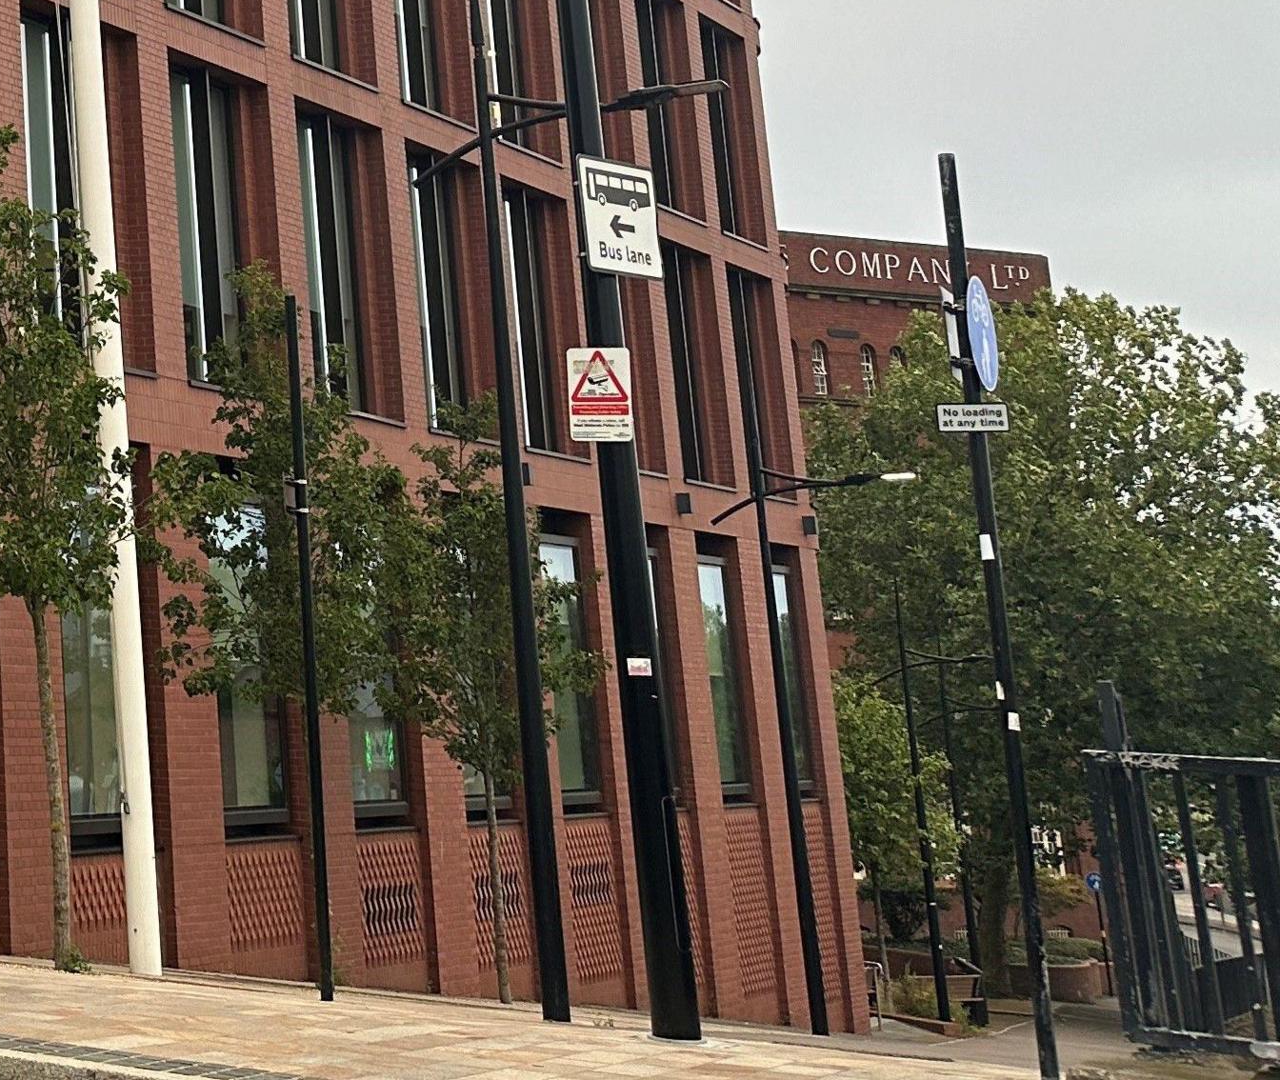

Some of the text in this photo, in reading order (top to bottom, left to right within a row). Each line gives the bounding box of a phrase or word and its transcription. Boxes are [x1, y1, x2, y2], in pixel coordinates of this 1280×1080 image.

[599, 241, 652, 266] Bus lane
[809, 247, 969, 284] COMPAN
[943, 408, 1002, 418] No loading
[943, 418, 1005, 428] at any time
